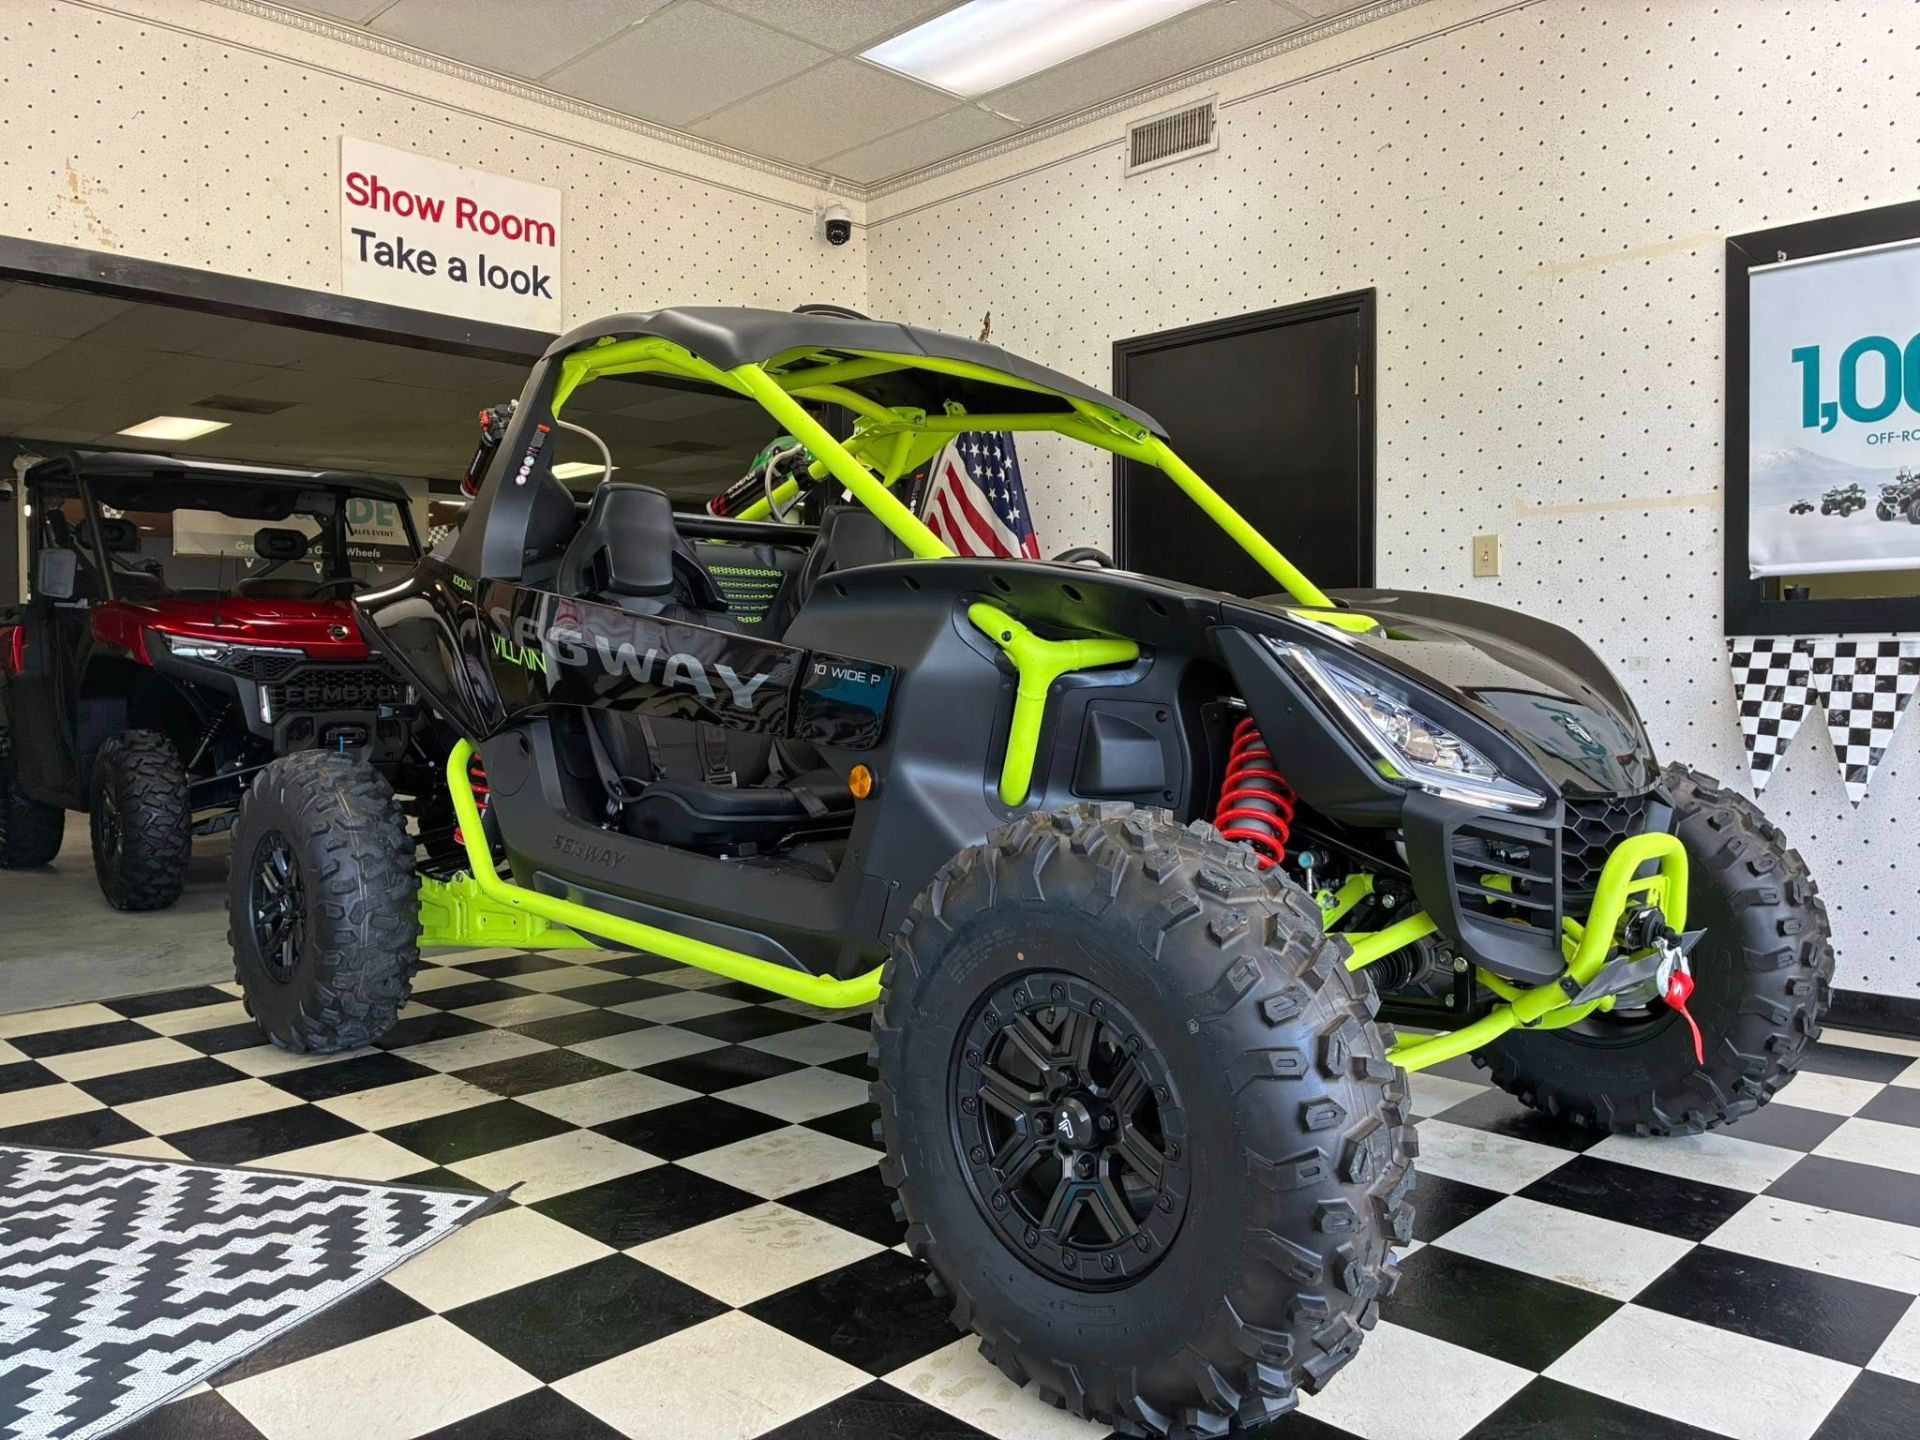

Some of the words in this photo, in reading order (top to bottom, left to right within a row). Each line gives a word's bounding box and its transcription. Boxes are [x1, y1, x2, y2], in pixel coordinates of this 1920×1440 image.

[345, 172, 445, 223] Show
[455, 196, 556, 247] Room
[351, 227, 437, 276] Take
[447, 256, 468, 283] a
[478, 254, 553, 299] look
[1791, 331, 1920, 434] 1,0
[349, 499, 393, 527] DE
[346, 547, 381, 558] Wheels
[490, 606, 770, 709] SEGWAY
[491, 632, 548, 674] VILLAIN
[813, 663, 827, 676] 10
[831, 666, 867, 683] WIDE
[870, 674, 881, 685] P
[550, 833, 627, 868] SEGWAY
